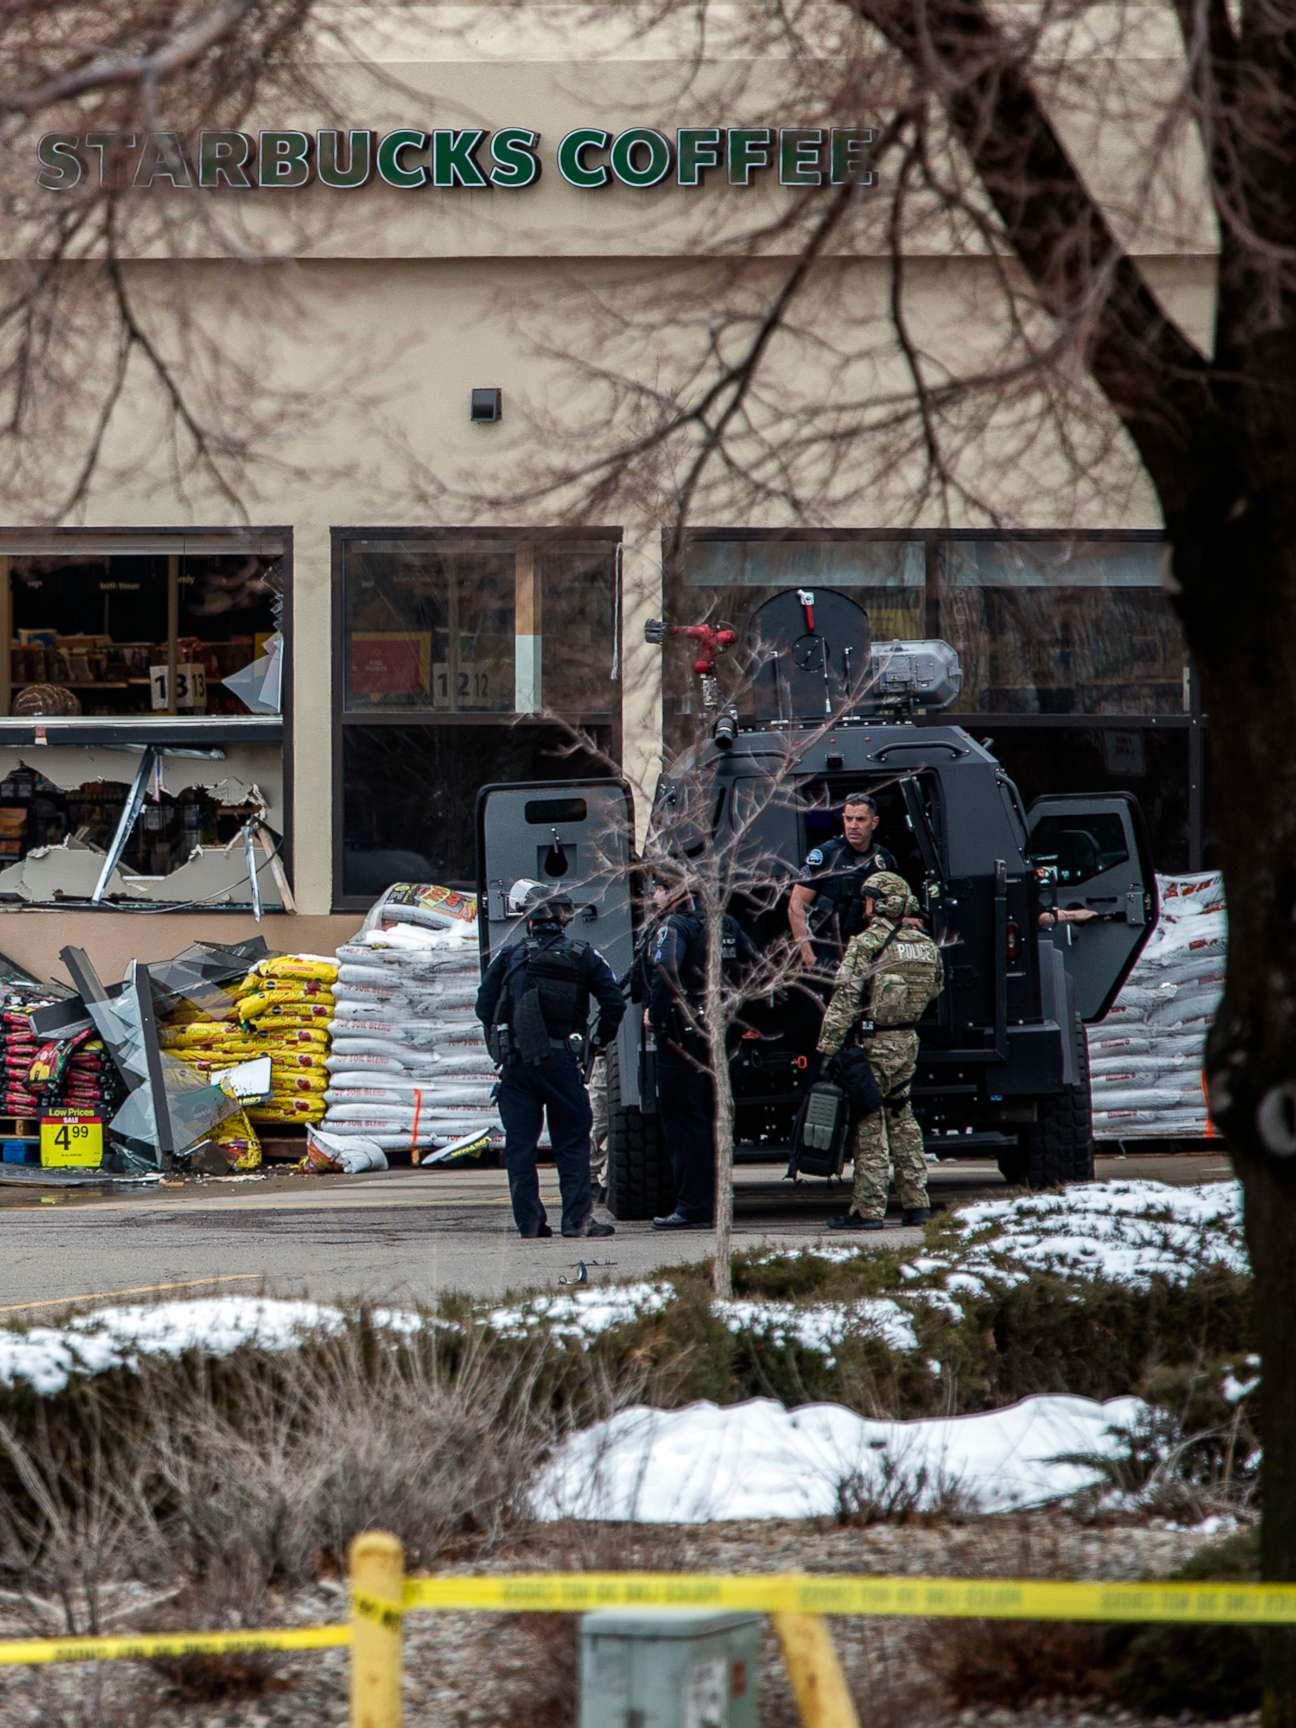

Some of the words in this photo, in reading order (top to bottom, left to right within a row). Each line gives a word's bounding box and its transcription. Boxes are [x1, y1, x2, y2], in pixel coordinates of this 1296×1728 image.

[36, 128, 542, 190] STARBUCKS
[557, 127, 877, 189] COFFEE
[49, 1107, 67, 1117] Low
[68, 1107, 95, 1117] Prices
